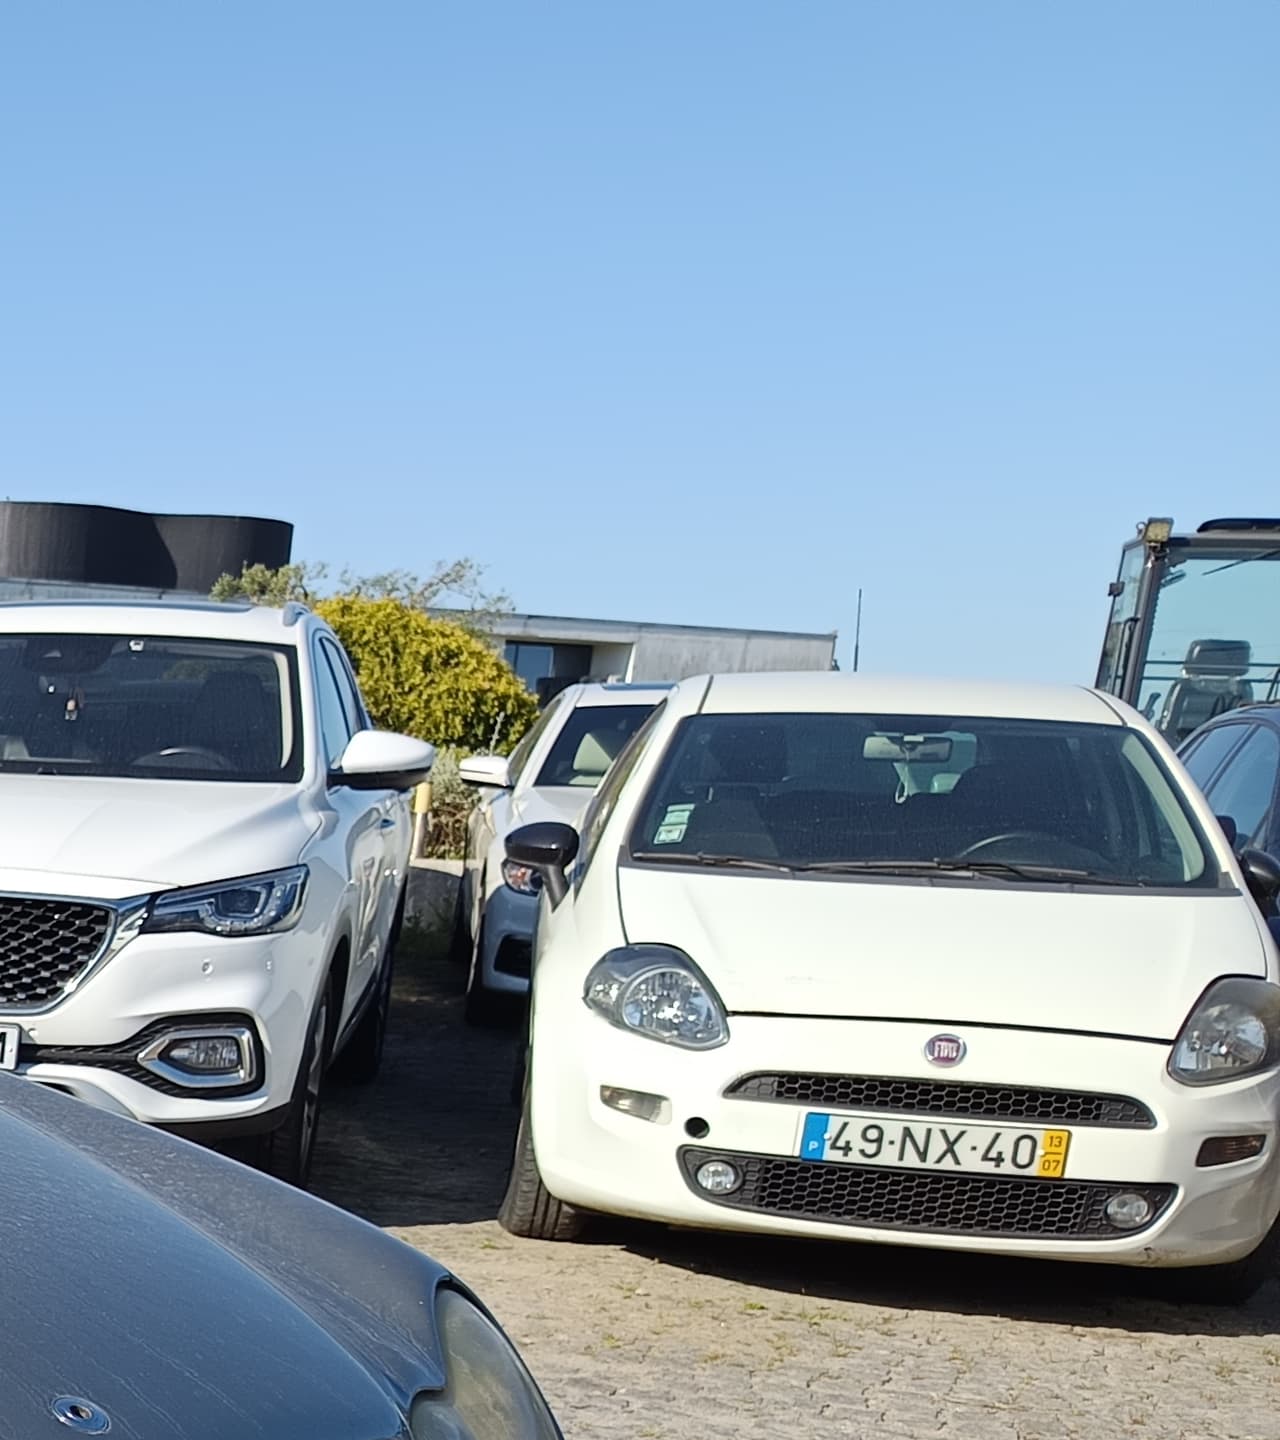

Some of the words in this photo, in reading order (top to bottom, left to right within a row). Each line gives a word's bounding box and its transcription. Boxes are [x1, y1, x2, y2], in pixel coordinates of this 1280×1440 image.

[808, 1140, 819, 1151] P
[1049, 1135, 1063, 1148] 13
[1042, 1159, 1061, 1172] 07
